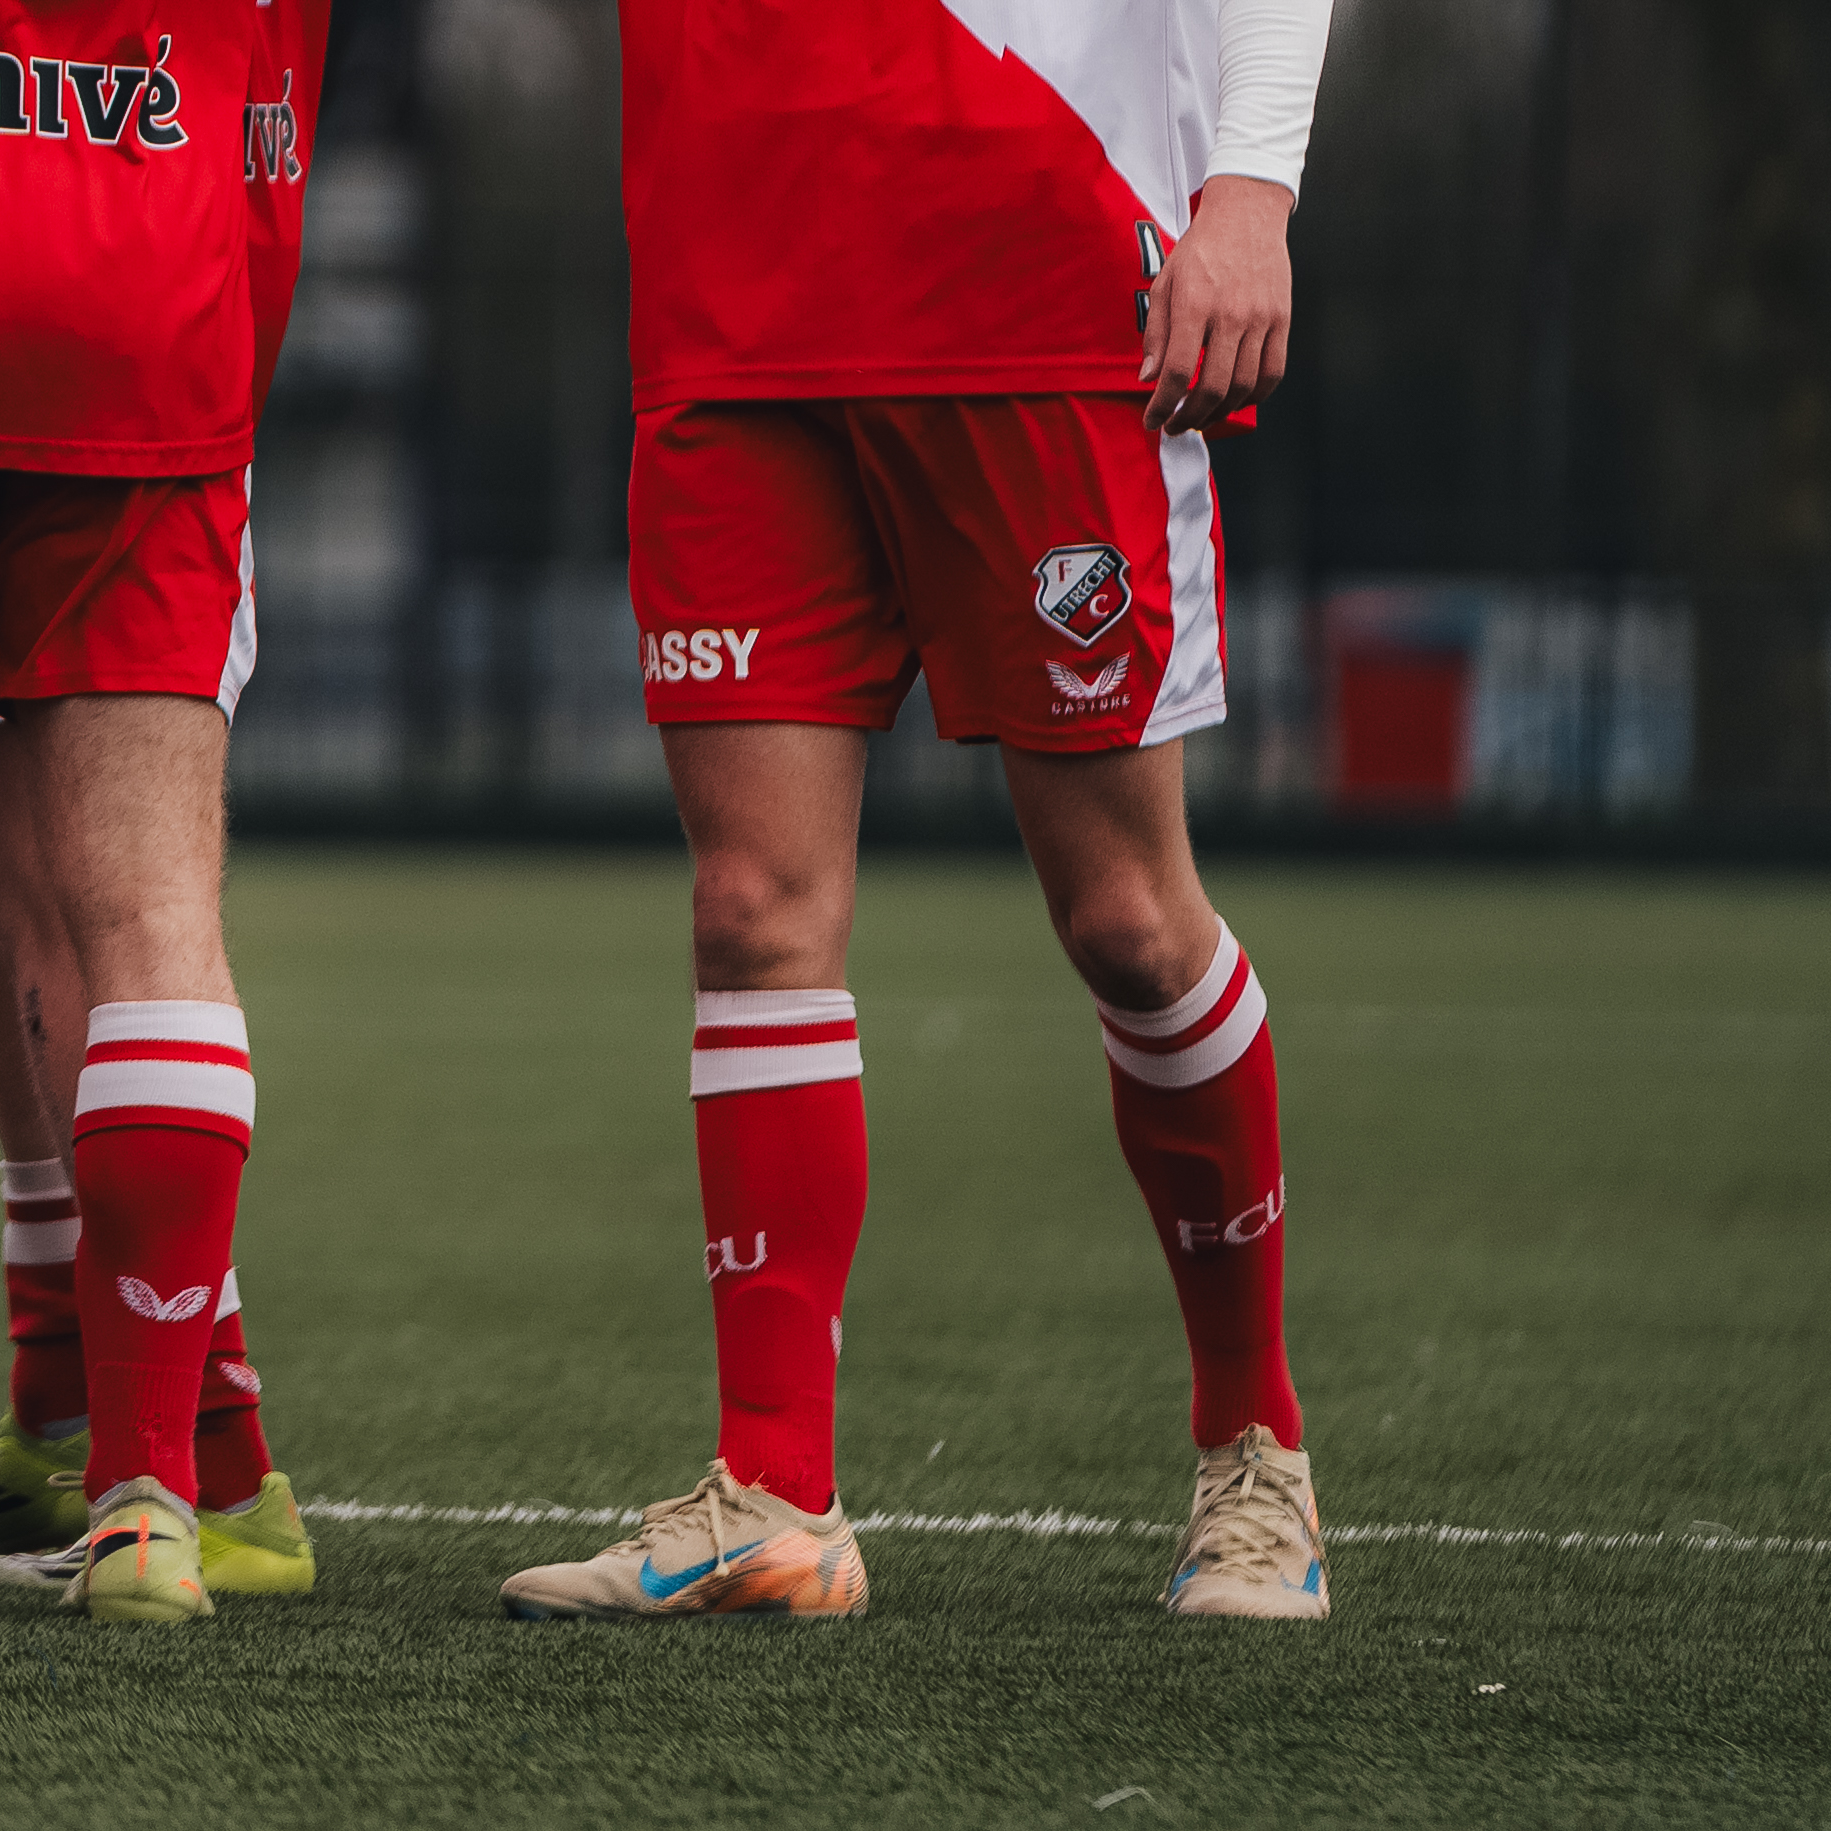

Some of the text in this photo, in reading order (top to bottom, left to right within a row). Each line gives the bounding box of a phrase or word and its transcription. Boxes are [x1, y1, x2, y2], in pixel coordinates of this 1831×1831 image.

[1051, 553, 1117, 624] UTRECHT
[1057, 558, 1073, 583] F
[1089, 593, 1109, 618] C
[639, 628, 760, 683] ASSY
[1051, 693, 1131, 717] CASTORE
[1178, 1172, 1287, 1253] FCU
